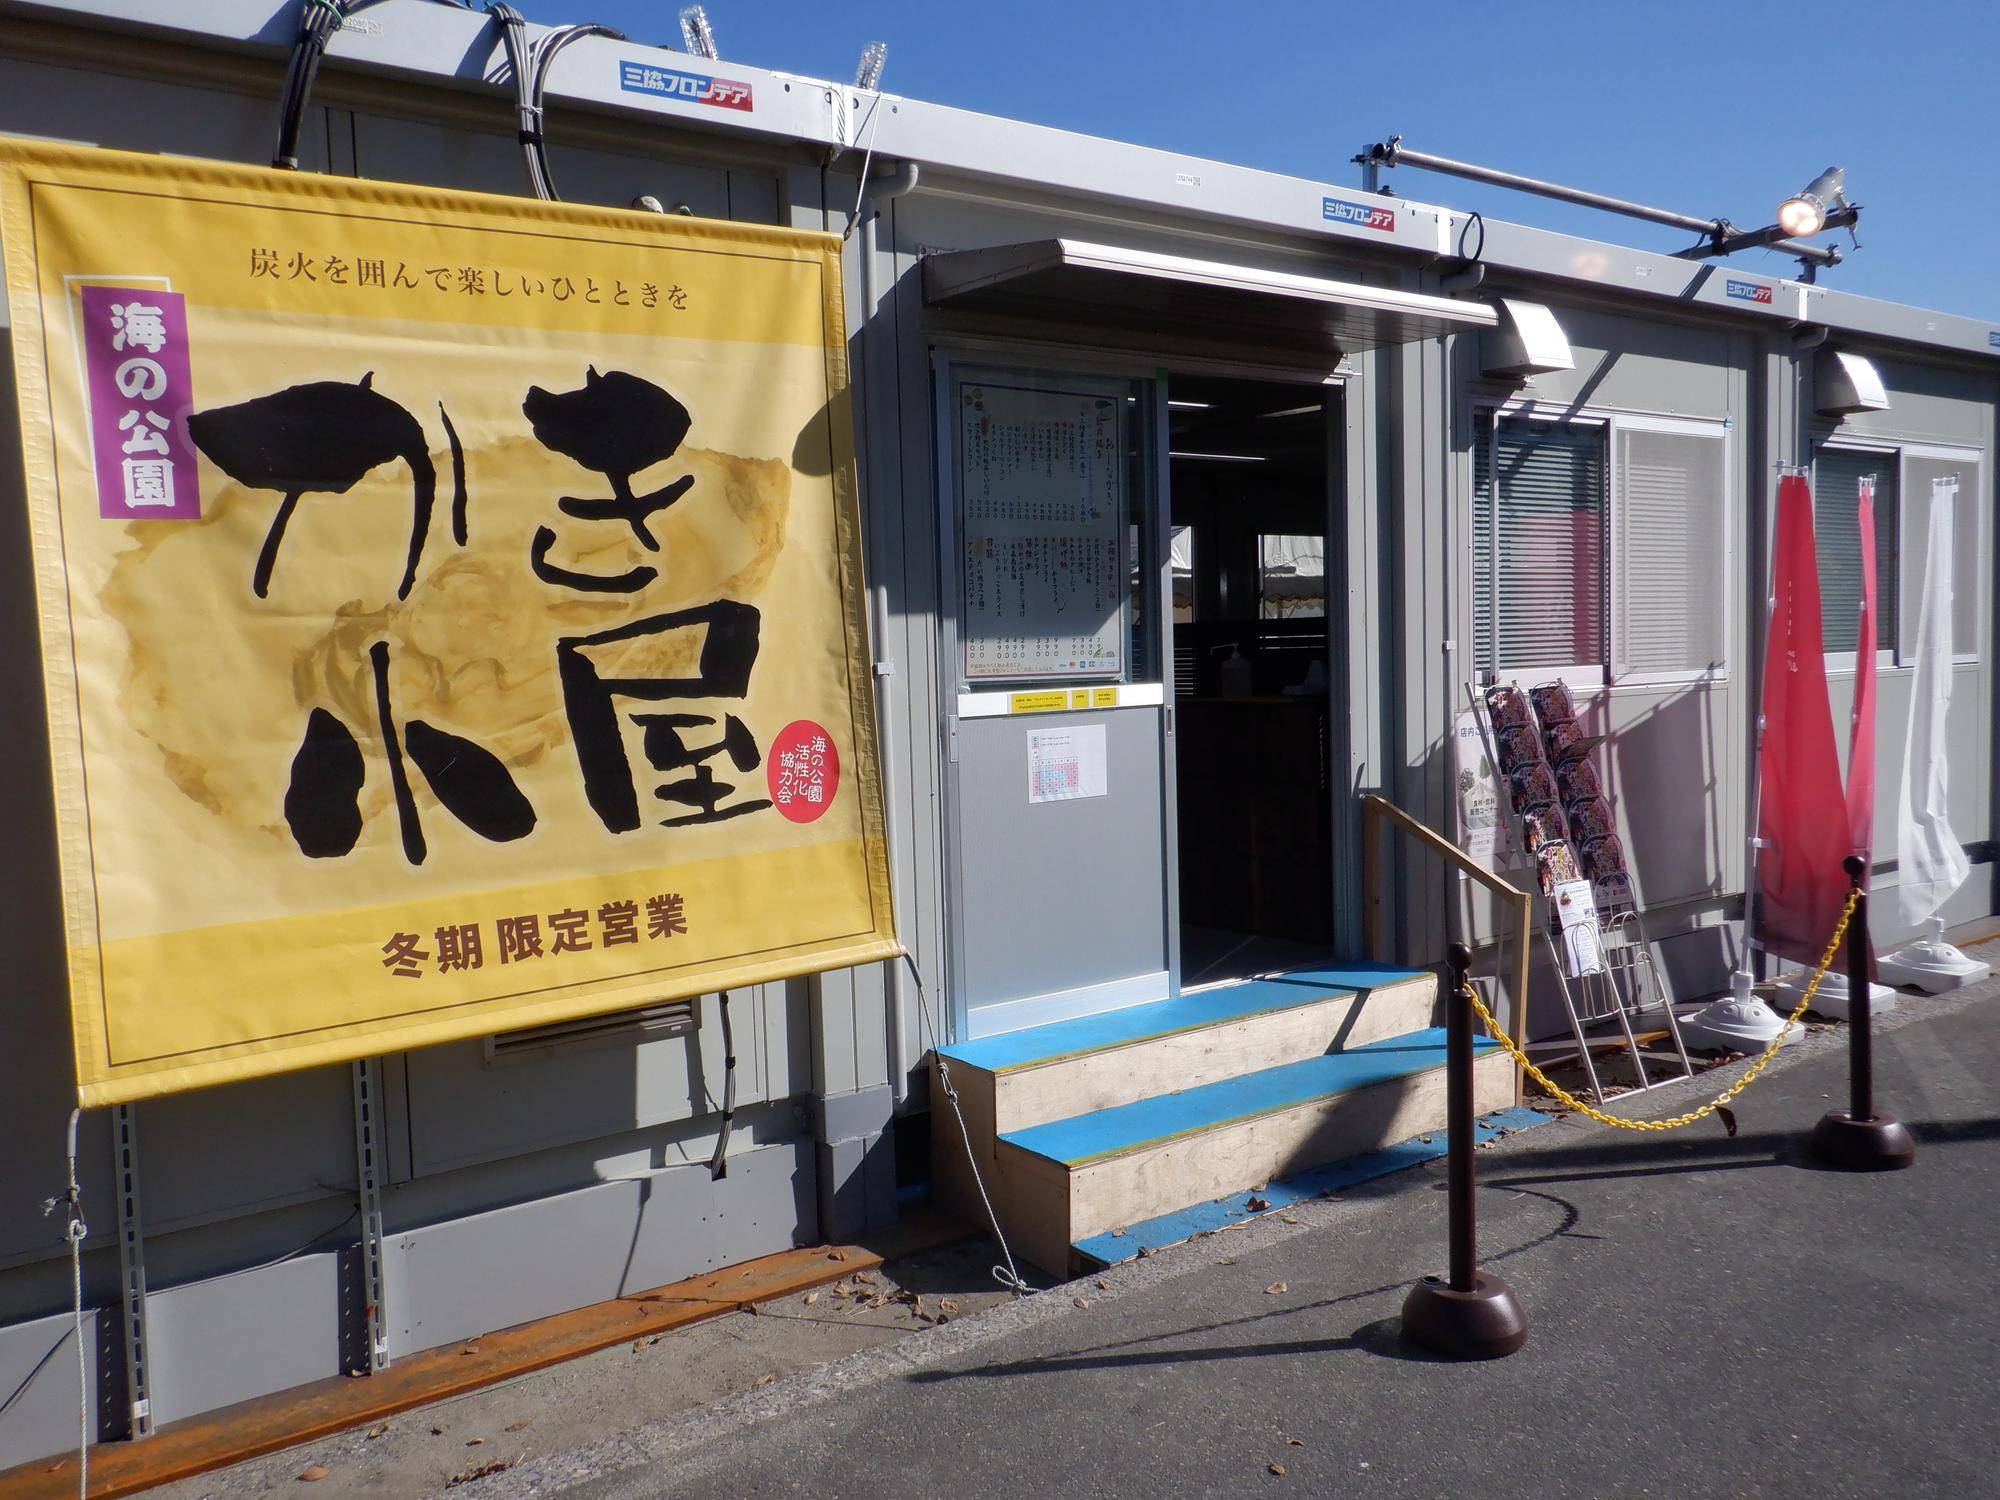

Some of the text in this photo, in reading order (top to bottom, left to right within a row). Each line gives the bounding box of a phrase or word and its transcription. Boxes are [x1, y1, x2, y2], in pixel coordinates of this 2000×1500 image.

[623, 66, 749, 105] 三協フロンテア
[1324, 201, 1393, 227] 三協フロンテア
[249, 247, 689, 311] 炭火を囲んで楽しいひとときを
[109, 301, 176, 508] 海の公園
[187, 365, 694, 601] かき
[284, 598, 774, 866] 小屋
[777, 750, 796, 804] 協力会
[793, 743, 811, 796] 活性化
[808, 735, 827, 803] 海の公園
[381, 892, 688, 979] 冬期限定営業
